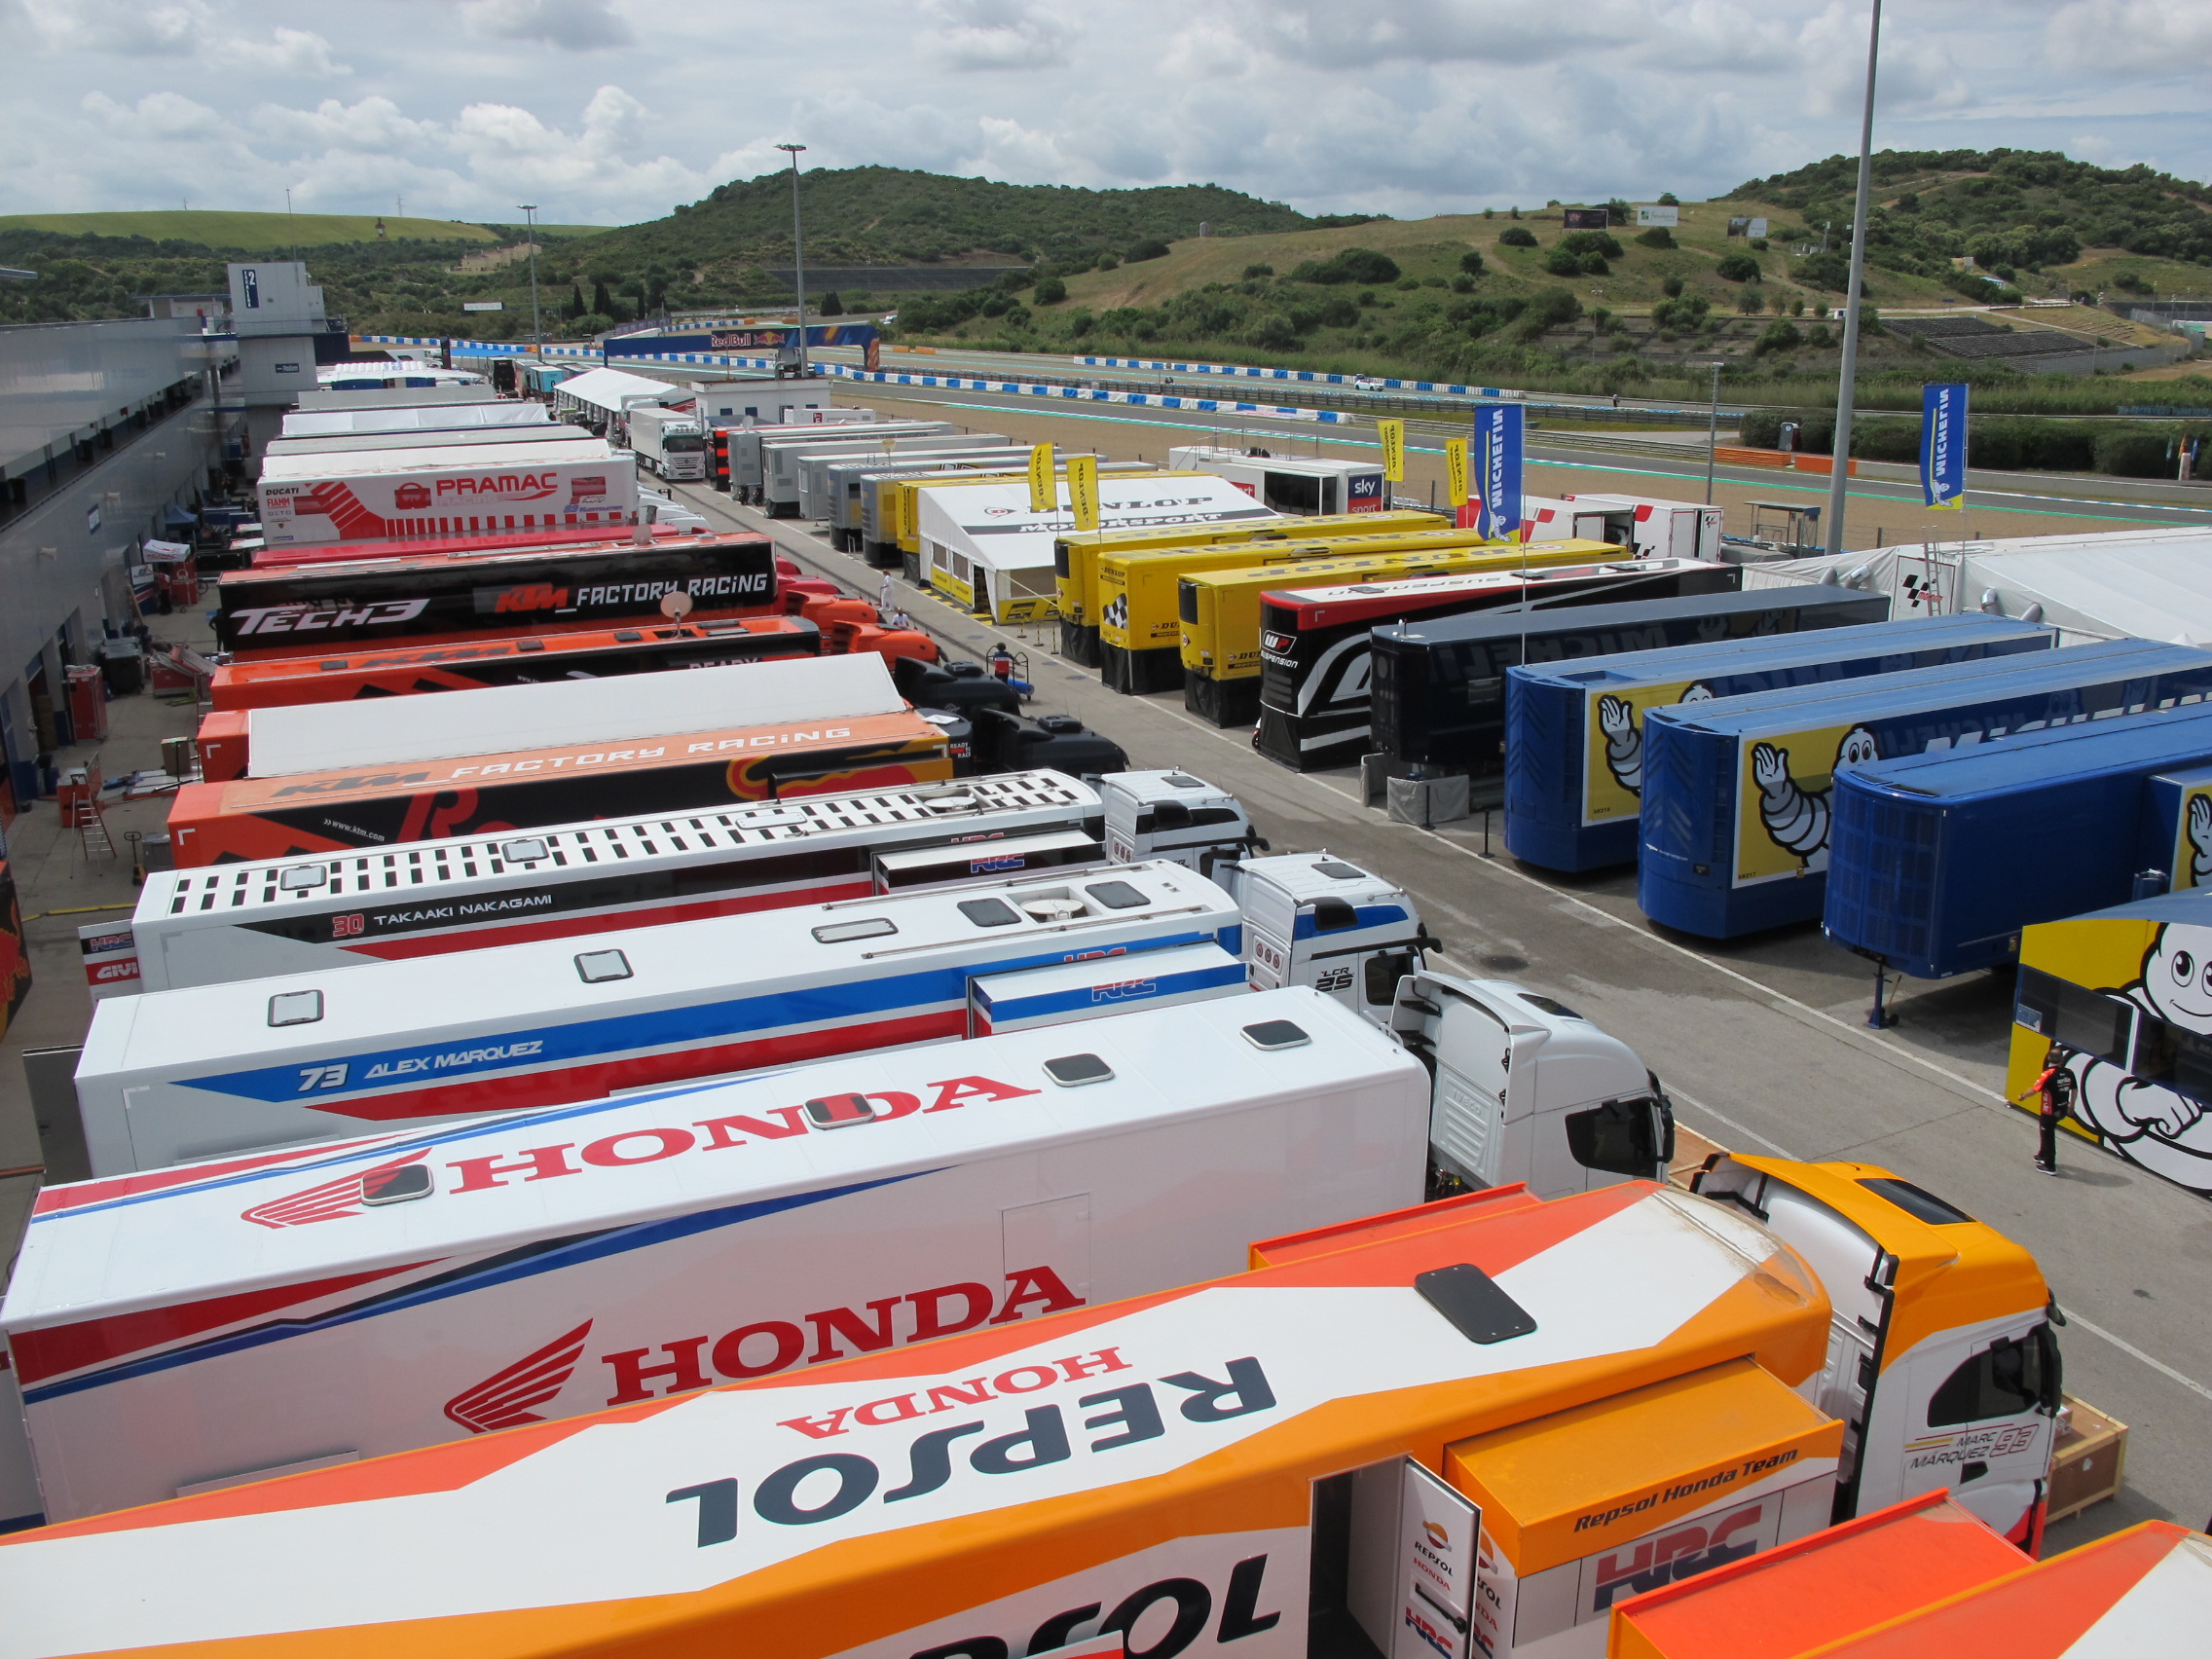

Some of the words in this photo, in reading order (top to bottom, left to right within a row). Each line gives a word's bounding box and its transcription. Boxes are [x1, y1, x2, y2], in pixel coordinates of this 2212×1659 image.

[248, 272, 255, 285] 2
[712, 335, 730, 347] Red
[731, 333, 751, 346] Bull
[436, 472, 558, 497] PRAMAC
[1354, 479, 1376, 496] sky
[495, 584, 569, 612] KTM
[230, 598, 430, 635] TECH3
[332, 820, 386, 841] www.ktm.com
[333, 913, 364, 937] 30
[374, 906, 454, 926] TAKAAKI
[461, 895, 552, 915] NAKAGAMI
[91, 934, 132, 952] HRC
[97, 962, 138, 978] GIVI
[1321, 967, 1349, 977] LCR
[298, 1063, 350, 1091] 73
[364, 1054, 429, 1080] ALEX
[434, 1040, 544, 1069] MARQUEZ
[449, 1075, 1042, 1195] HONDA
[602, 1266, 1087, 1407] HONDA
[776, 1346, 1133, 1439] HONDA
[666, 1356, 1276, 1548] REPSOL
[1957, 1432, 1997, 1447] MARC
[1910, 1446, 1990, 1468] MÁRQUEZ
[1574, 1493, 1656, 1532] Repsol
[1662, 1470, 1737, 1501] Honda
[1741, 1448, 1799, 1477] Team
[1415, 1541, 1454, 1576] REPSOL
[1594, 1504, 1761, 1612] HRC
[1414, 1558, 1451, 1592] HONDA
